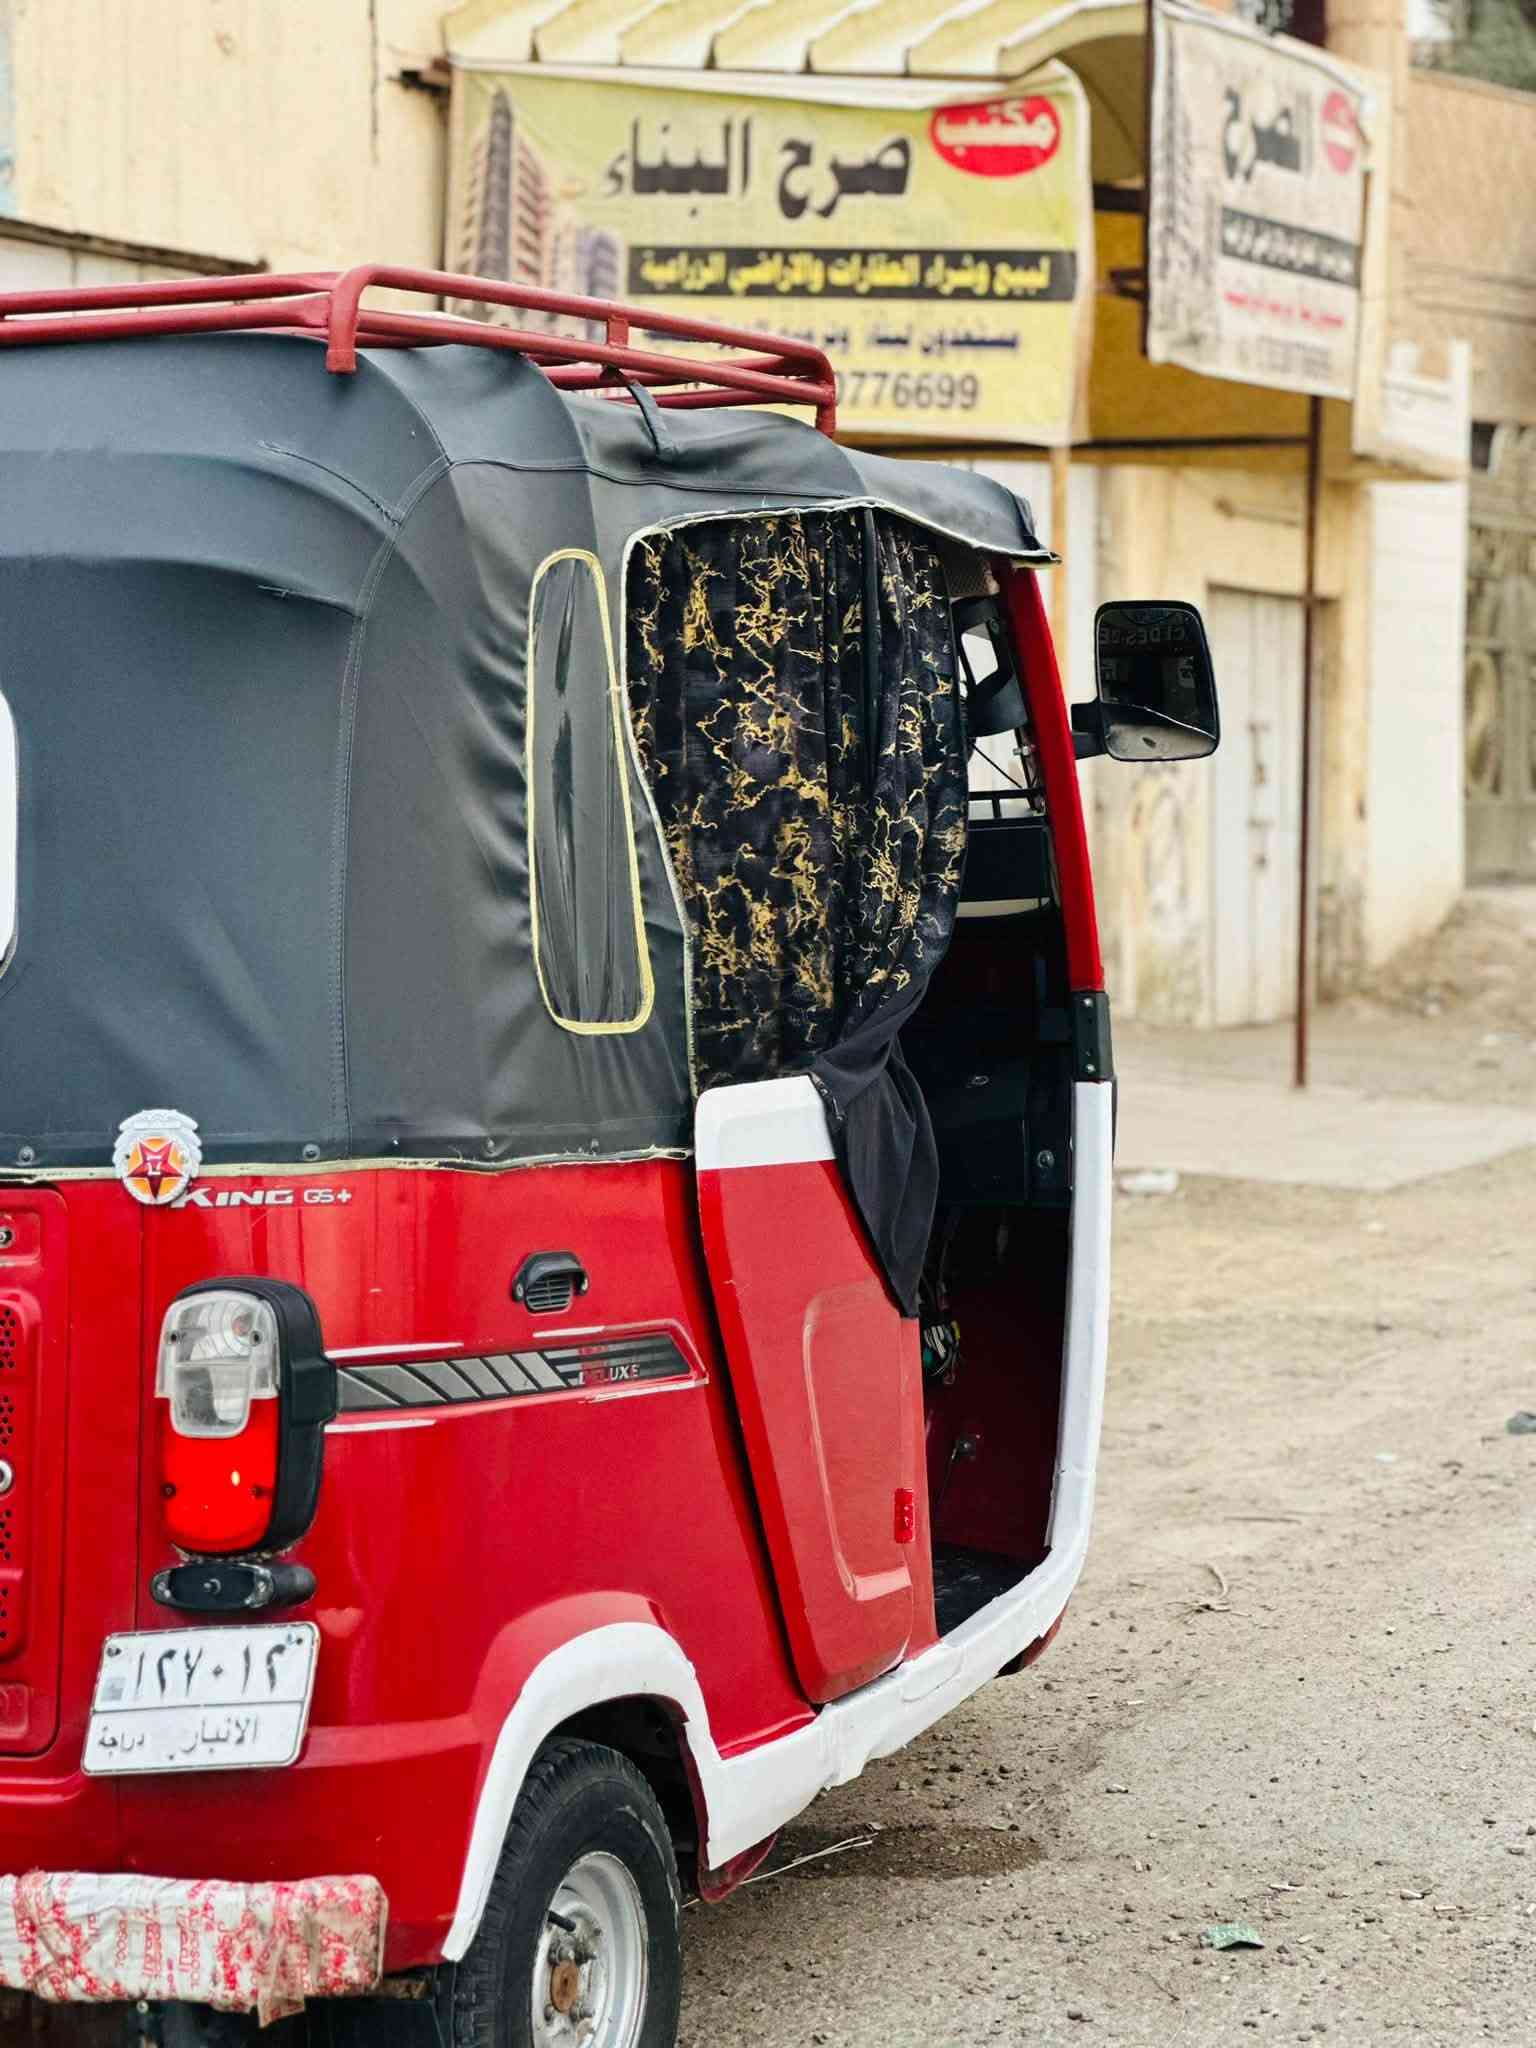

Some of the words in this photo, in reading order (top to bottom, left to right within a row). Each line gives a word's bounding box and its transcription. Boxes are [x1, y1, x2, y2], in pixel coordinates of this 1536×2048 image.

[936, 101, 1058, 157] مكتب
[604, 114, 751, 218] البناء
[777, 137, 911, 219] صرح
[827, 252, 920, 296] العقارات
[925, 253, 990, 296] وشراء
[993, 256, 1050, 297] لبيع
[170, 1187, 294, 1208] KING
